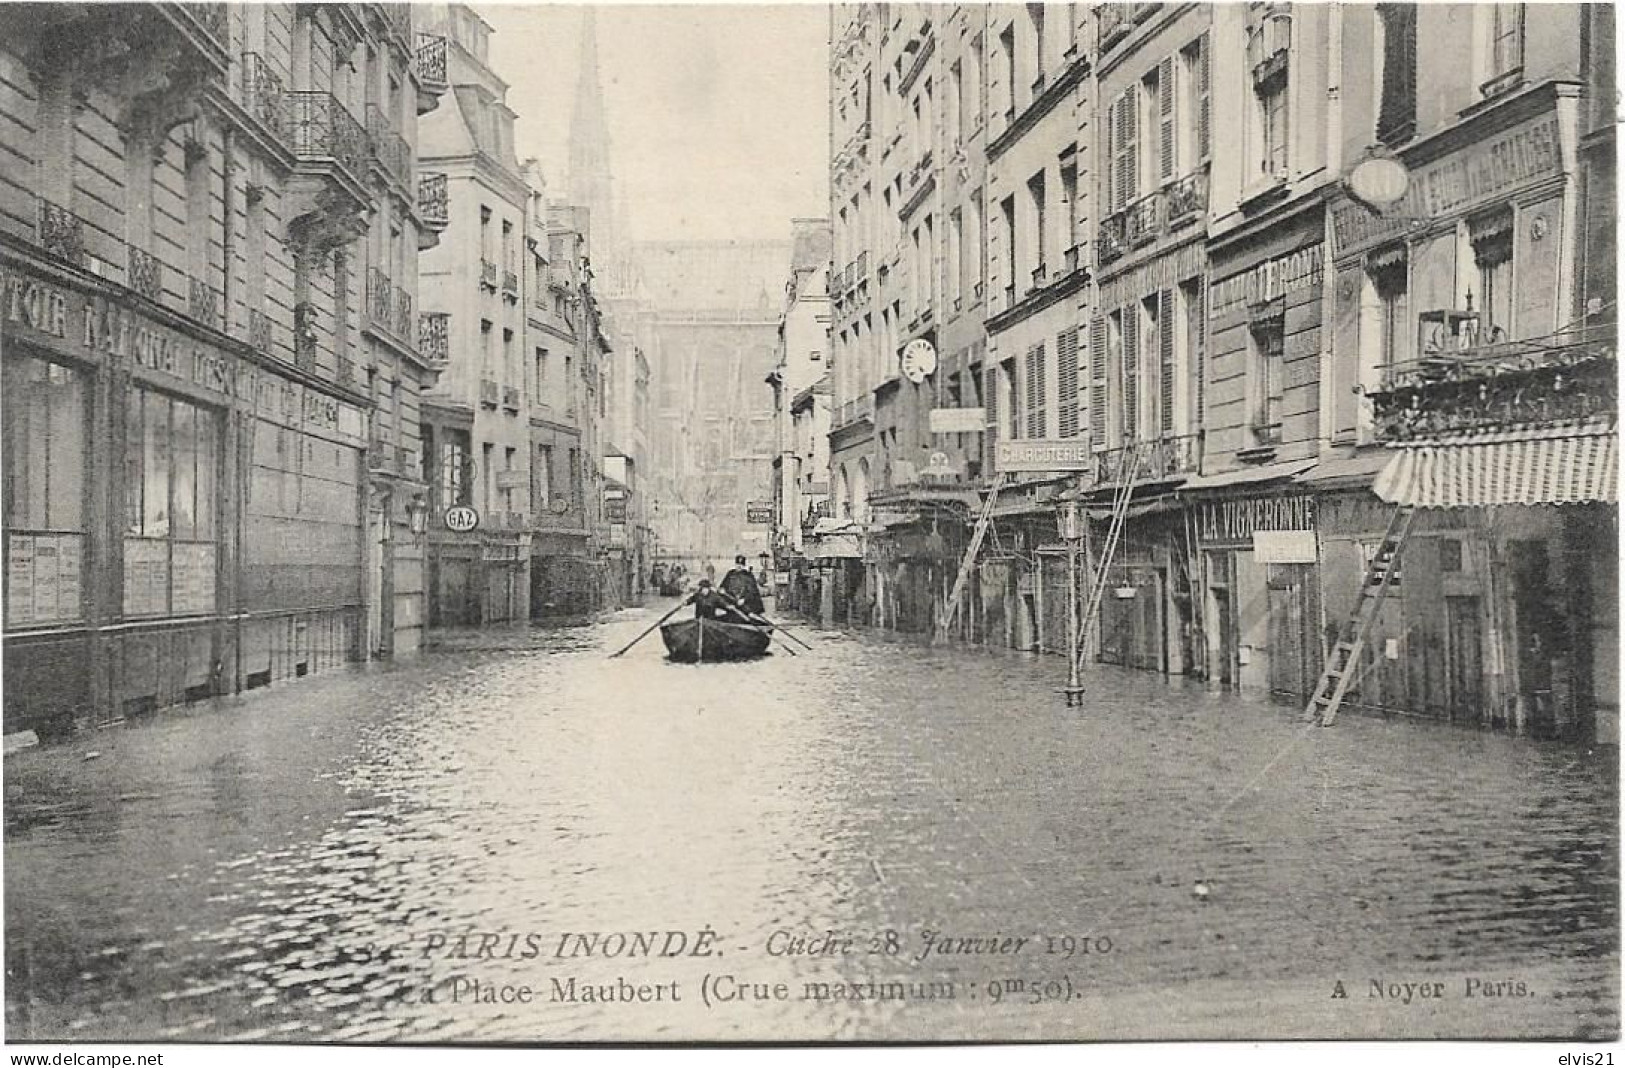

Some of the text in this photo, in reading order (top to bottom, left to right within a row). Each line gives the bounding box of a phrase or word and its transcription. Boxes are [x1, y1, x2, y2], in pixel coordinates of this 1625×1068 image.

[448, 509, 474, 527] GAZ
[1202, 495, 1314, 540] LA VIGNERONNE
